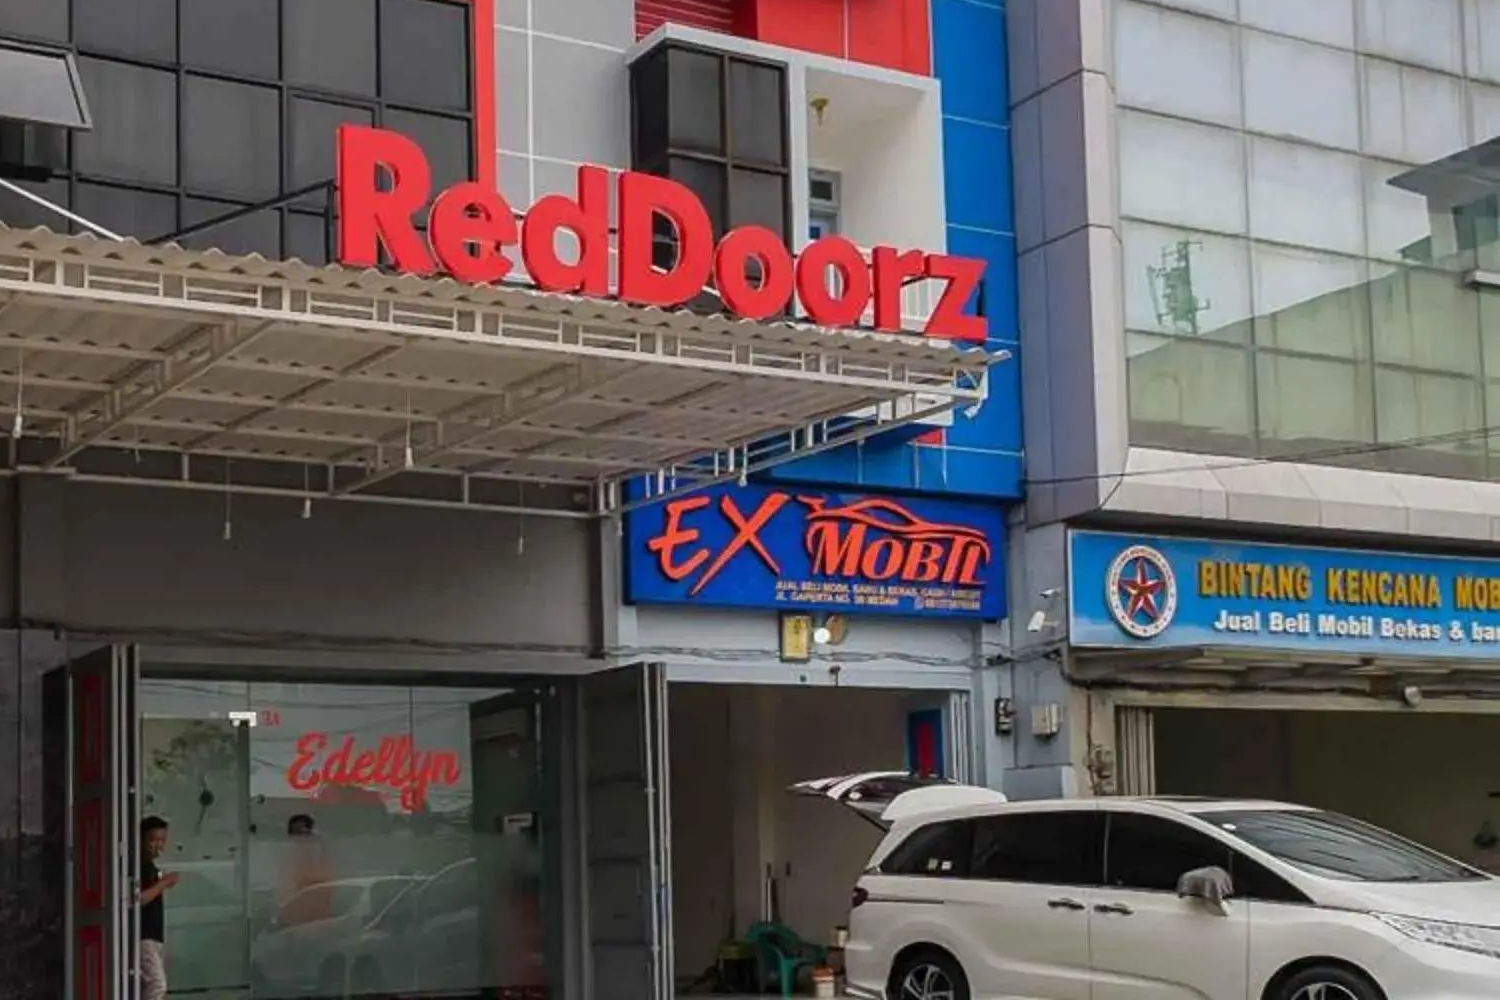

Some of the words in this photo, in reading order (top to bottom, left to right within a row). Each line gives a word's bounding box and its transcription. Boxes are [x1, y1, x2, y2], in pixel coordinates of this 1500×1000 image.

[337, 123, 989, 343] RedDoorz
[648, 492, 792, 596] EX
[1199, 560, 1312, 600] BINTANG
[1327, 567, 1441, 608] KENCANA
[1214, 610, 1261, 632] Jual
[1269, 612, 1311, 635] Beli
[1318, 615, 1373, 638] Mobil
[1380, 618, 1442, 641] Bekas
[1450, 621, 1464, 640] &
[287, 731, 461, 814] Edellyn
